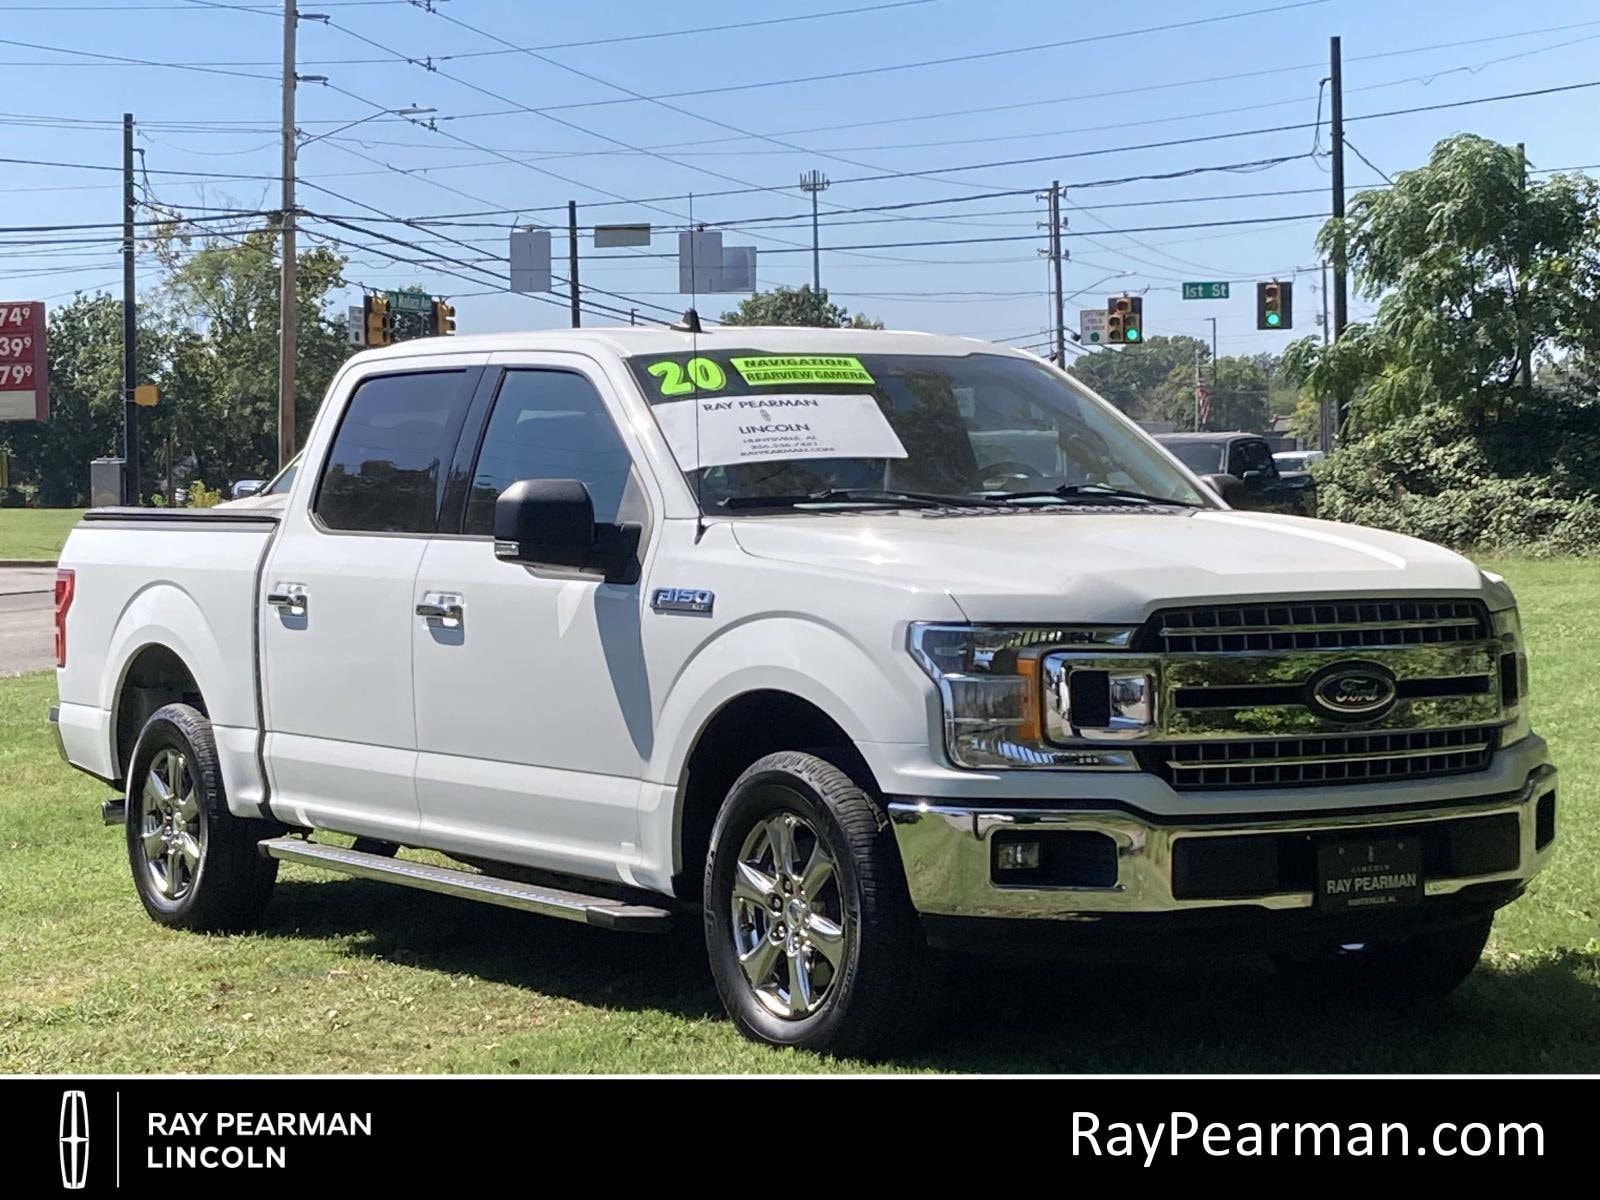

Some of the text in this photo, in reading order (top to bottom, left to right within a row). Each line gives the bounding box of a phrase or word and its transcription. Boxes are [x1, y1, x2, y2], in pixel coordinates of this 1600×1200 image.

[1211, 283, 1227, 297] St
[743, 358, 851, 369] NAVIGATION
[648, 357, 727, 396] 20
[745, 370, 870, 381] REARVIEW CAMERA
[702, 399, 819, 412] RAY PEARMAN
[738, 422, 811, 435] LINCOLN
[1326, 873, 1417, 895] RAY PEARMAN
